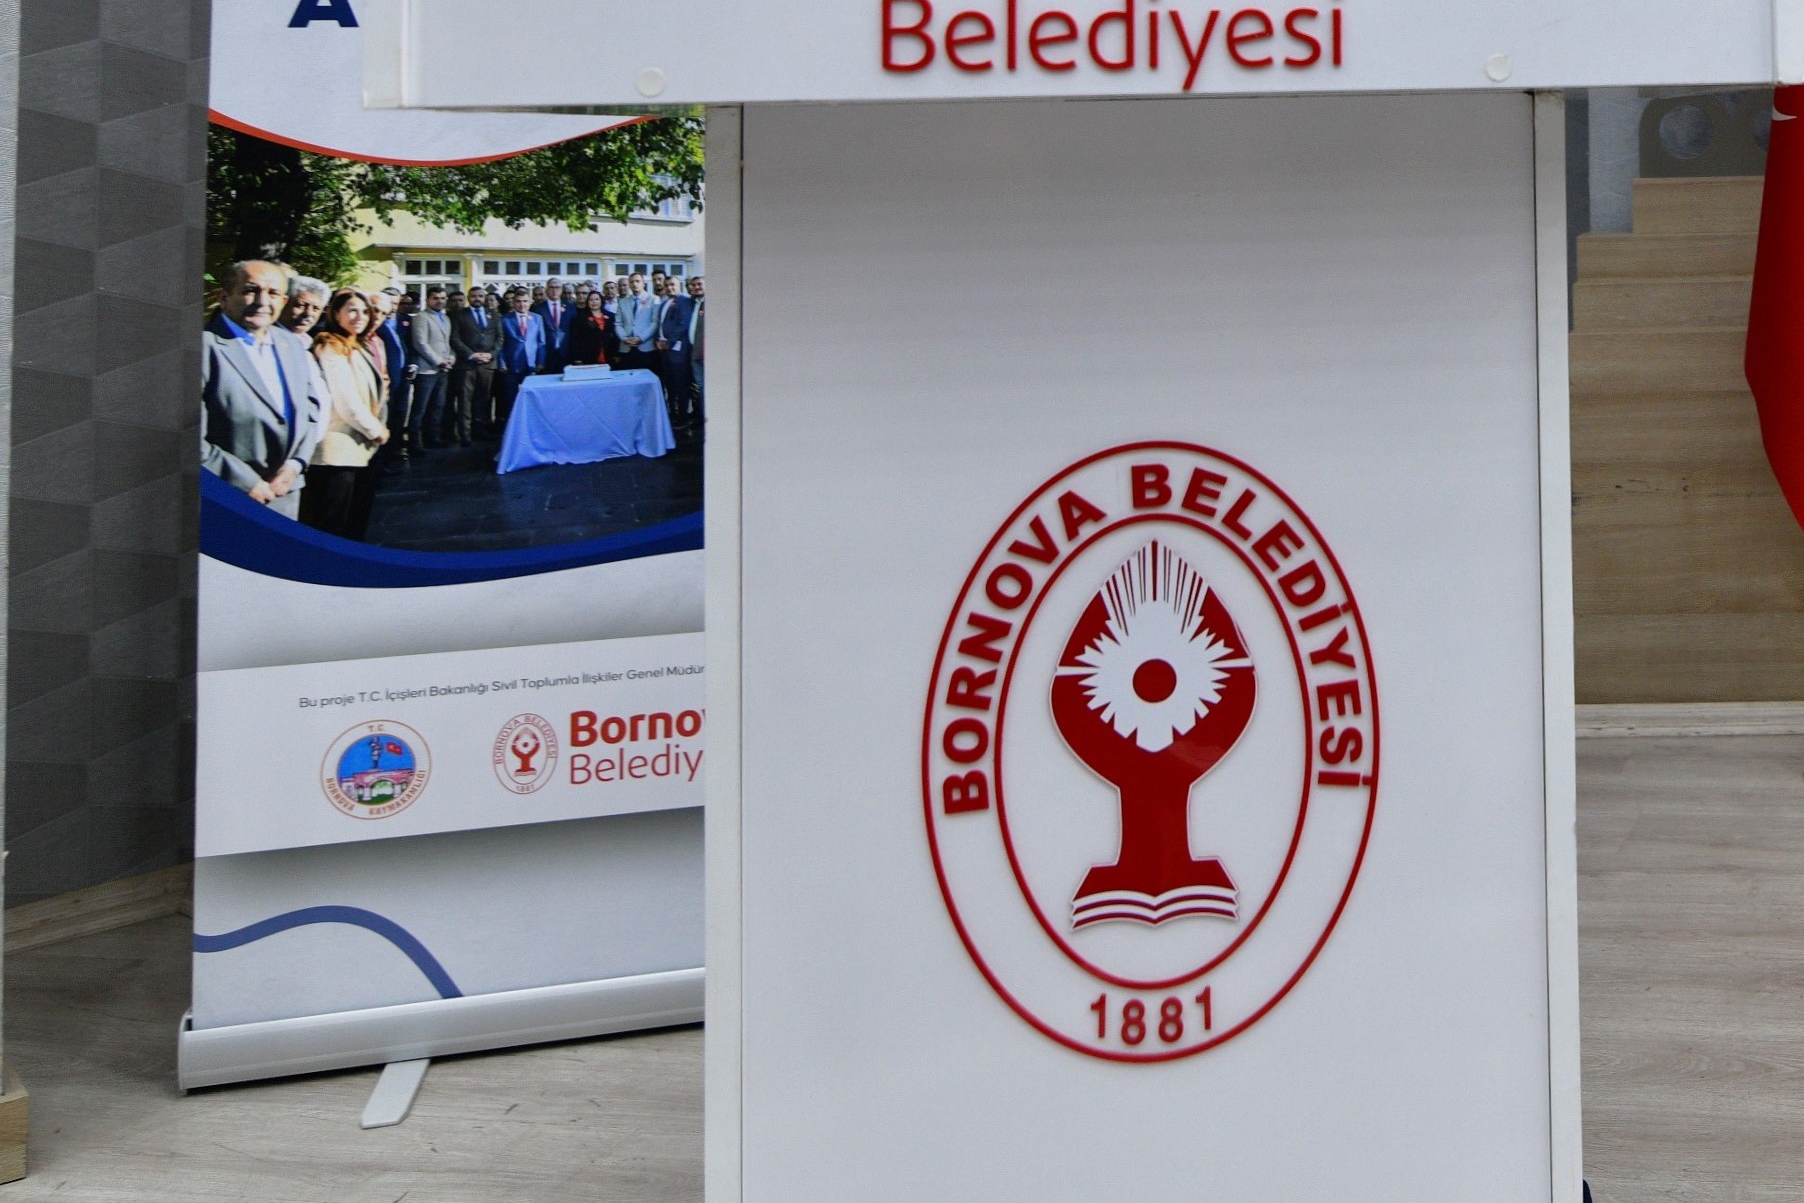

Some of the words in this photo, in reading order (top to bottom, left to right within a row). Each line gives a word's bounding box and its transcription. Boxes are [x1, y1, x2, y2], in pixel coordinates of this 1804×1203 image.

[942, 489, 1108, 816] BORNOVA
[1130, 463, 1373, 790] BELEDİYESİ
[299, 697, 318, 708] Bu
[320, 694, 355, 709] proje
[429, 681, 490, 698] Bakanlığı
[491, 679, 517, 692] Sivil
[520, 677, 580, 691] Toplumla
[626, 667, 664, 680] Genel
[569, 709, 706, 748] Borno
[1090, 985, 1213, 1046] 1881
